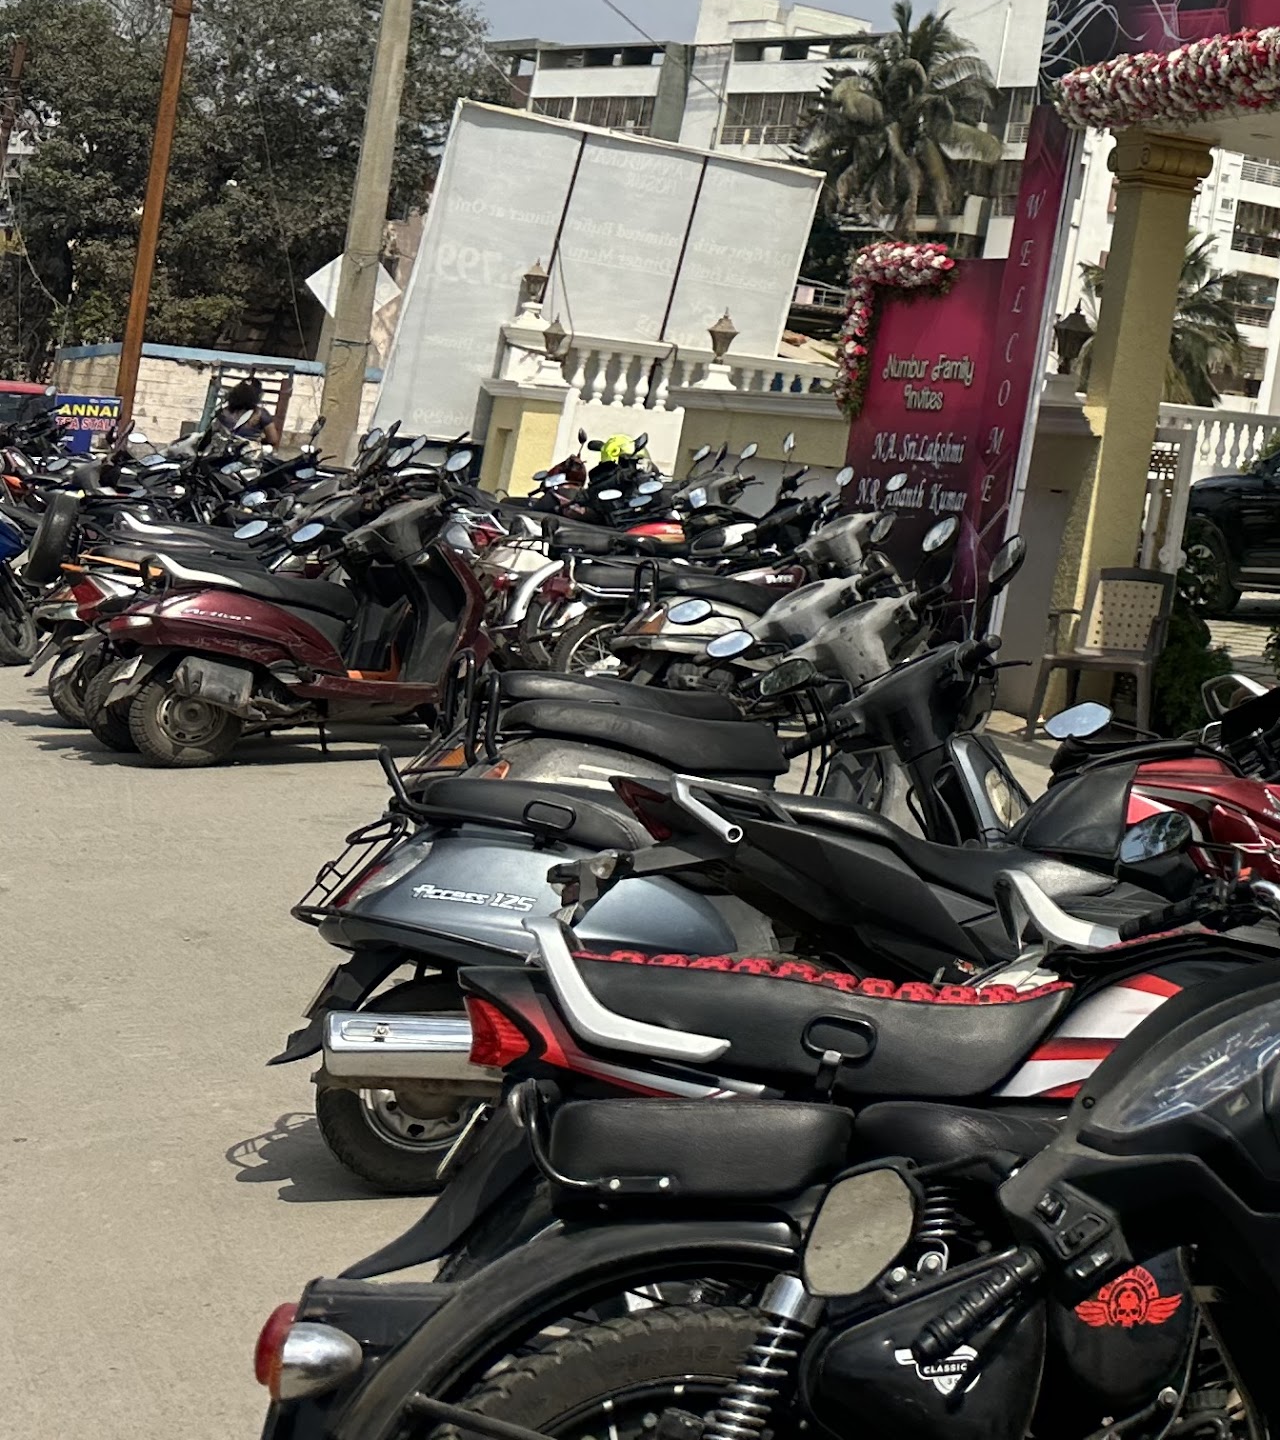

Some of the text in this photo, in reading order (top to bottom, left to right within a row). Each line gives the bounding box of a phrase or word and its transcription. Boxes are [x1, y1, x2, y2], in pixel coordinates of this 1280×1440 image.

[980, 189, 1048, 503] WELCOME
[931, 354, 975, 387] Family
[904, 384, 944, 410] Invites
[58, 403, 119, 418] ANNAI
[489, 892, 538, 913] 125
[923, 1363, 968, 1375] CLASSIC
